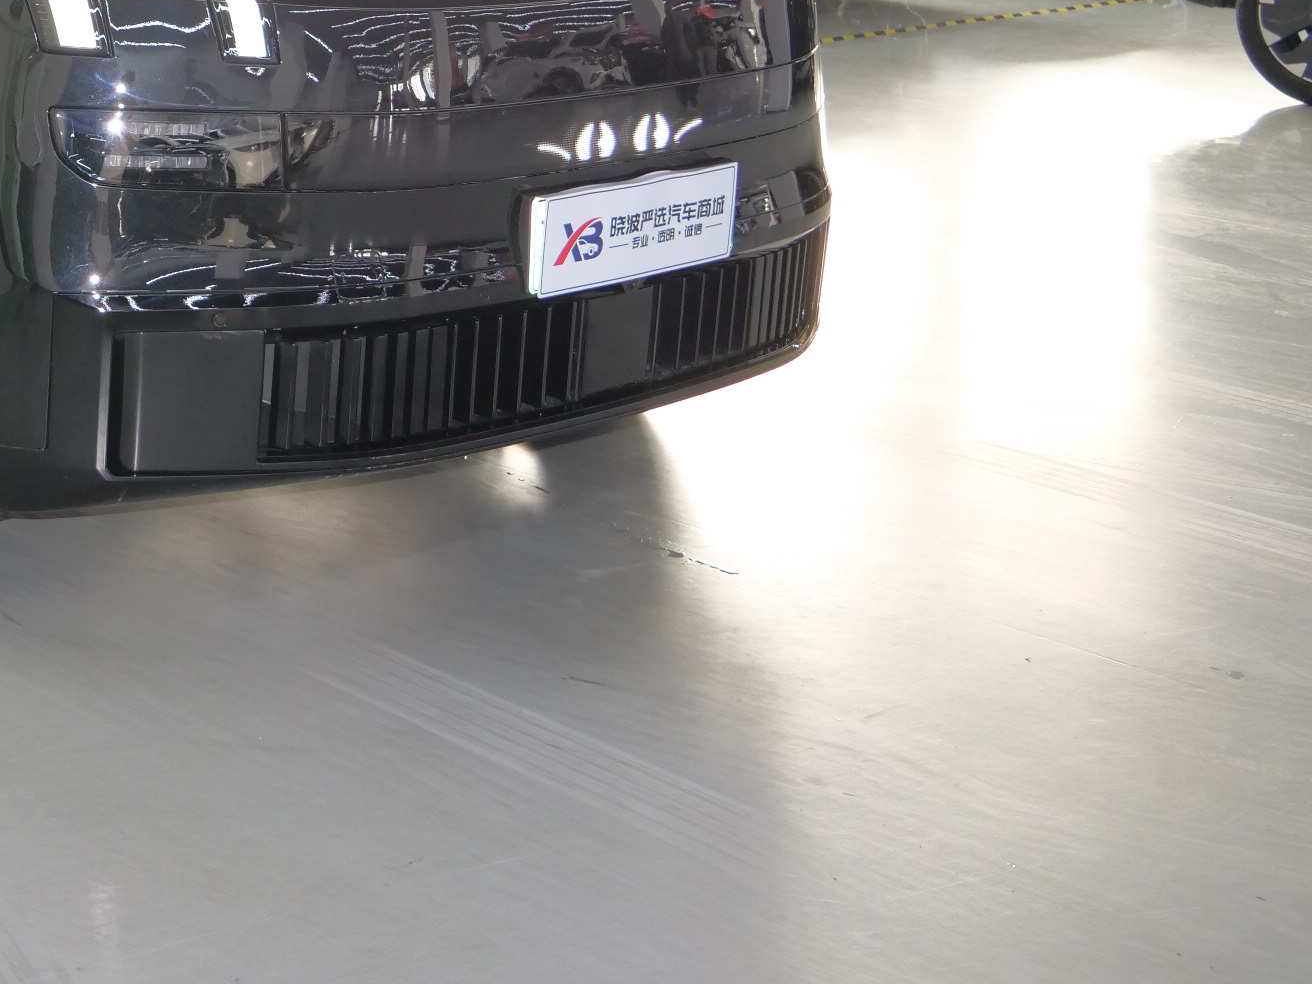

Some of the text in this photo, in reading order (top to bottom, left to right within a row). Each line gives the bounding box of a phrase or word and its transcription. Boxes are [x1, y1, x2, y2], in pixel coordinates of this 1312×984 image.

[609, 194, 726, 238] 晓波严选汽车商城
